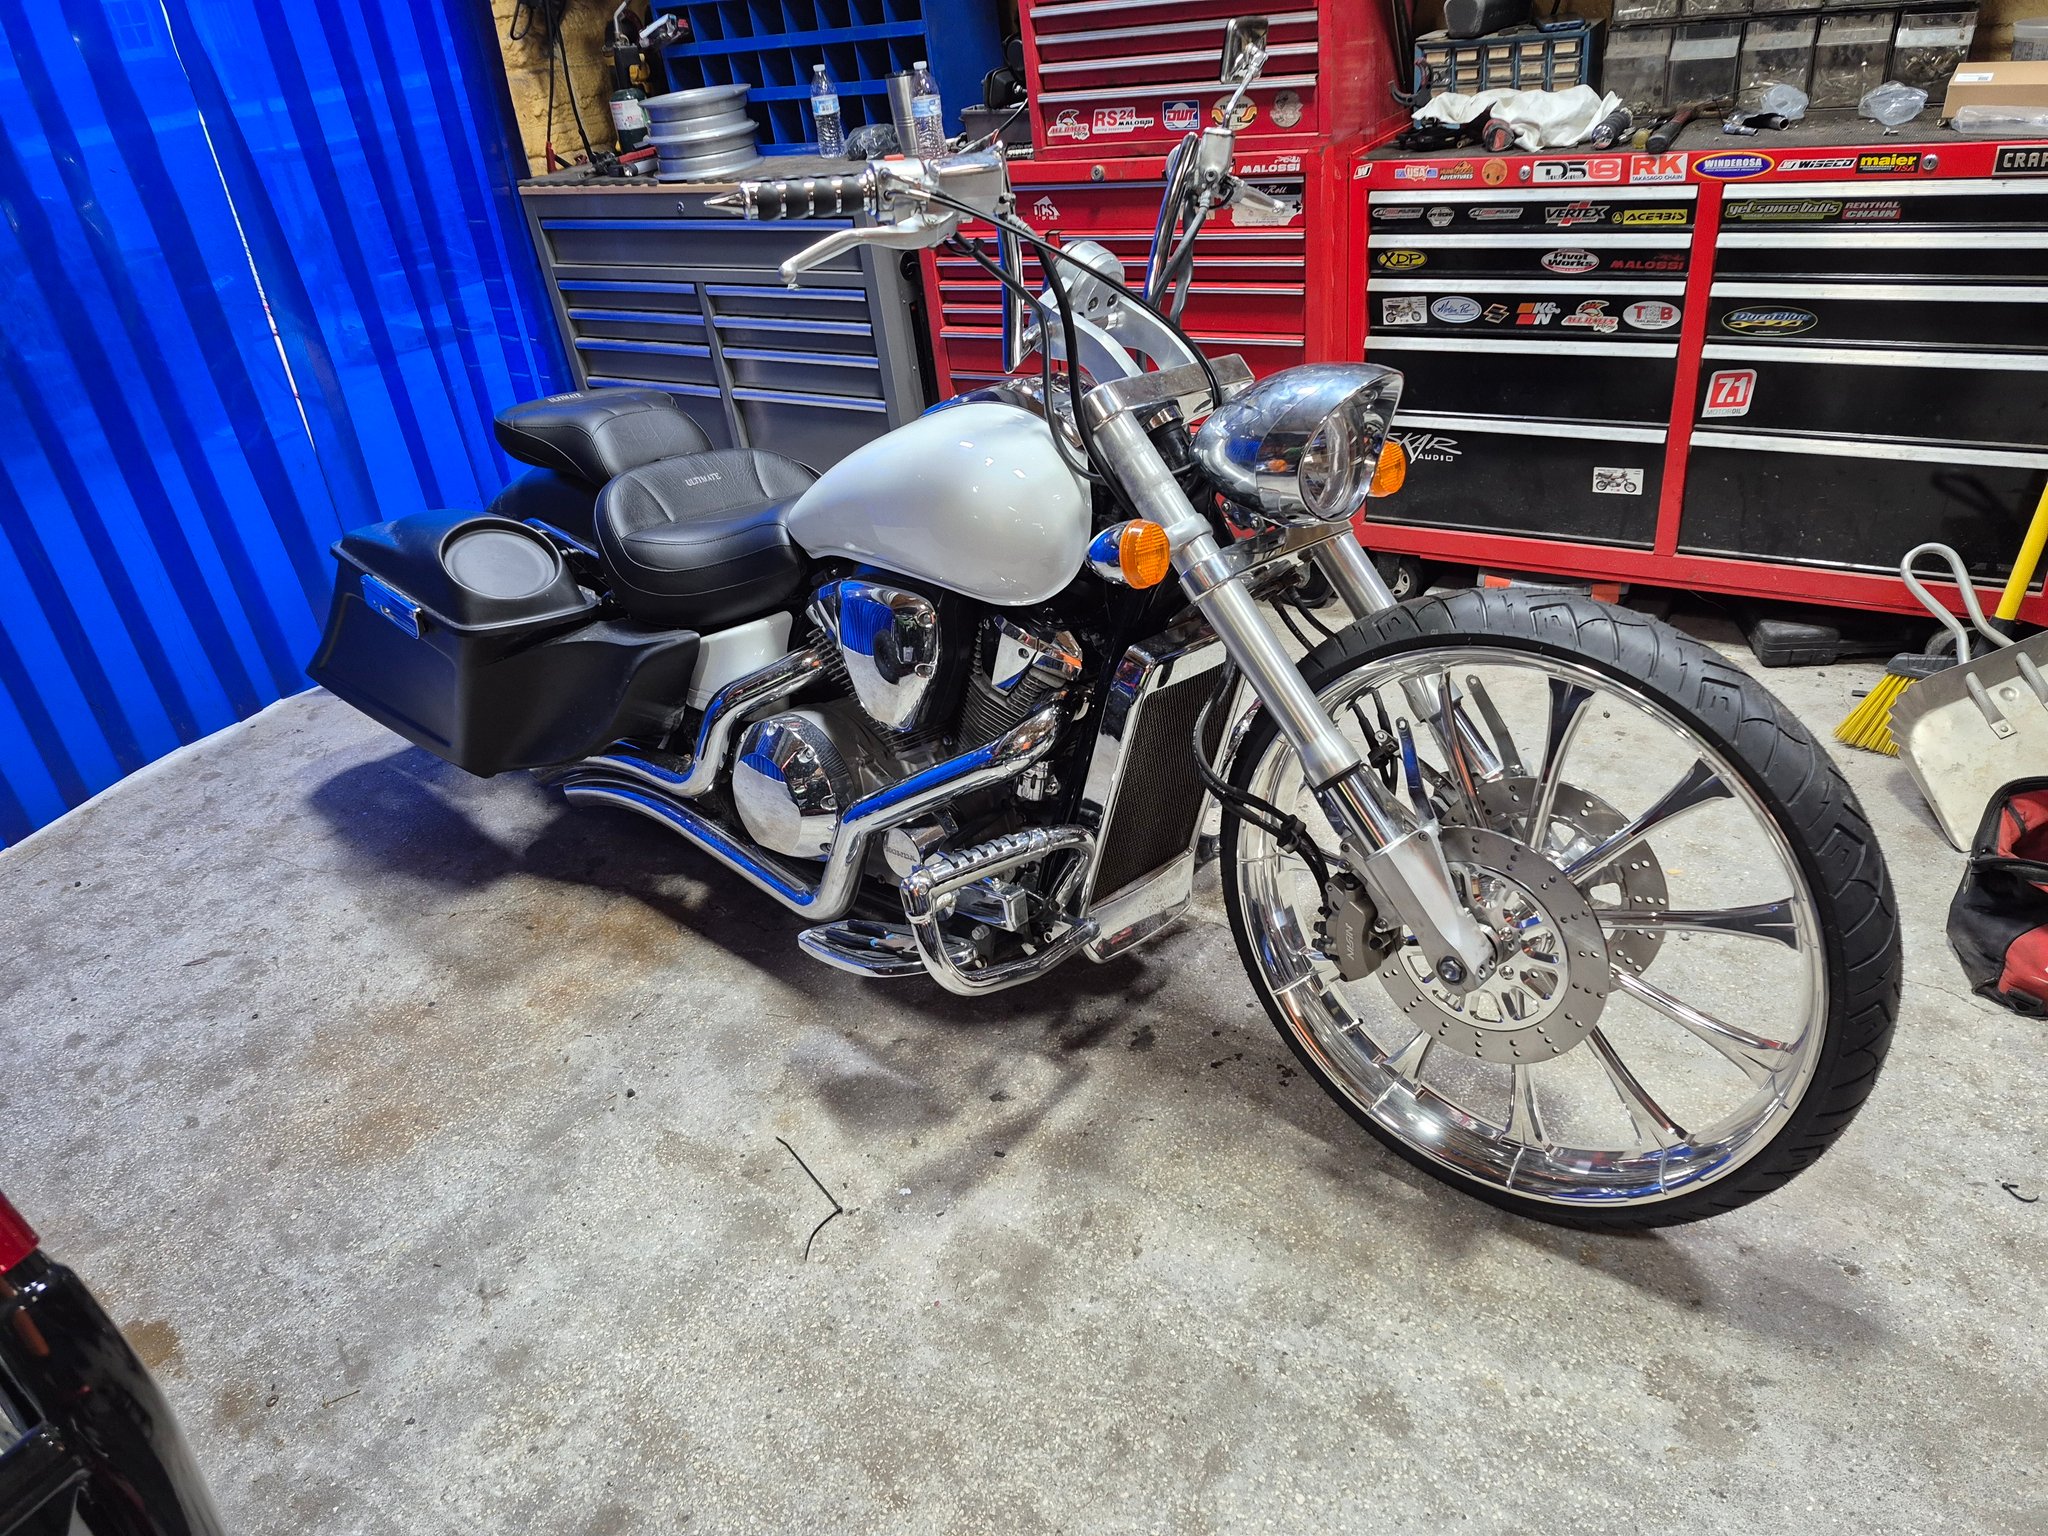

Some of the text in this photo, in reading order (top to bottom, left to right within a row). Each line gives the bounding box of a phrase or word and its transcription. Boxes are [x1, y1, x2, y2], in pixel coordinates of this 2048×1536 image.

[1632, 155, 1683, 175] RK
[1705, 158, 1762, 168] WINDEROSA
[1860, 154, 1917, 166] maier
[1240, 163, 1300, 173] MALOSSI
[1406, 166, 1426, 177] USA
[1535, 160, 1621, 180] DS18
[1844, 201, 1900, 209] RENTHAL
[1547, 207, 1607, 219] VERTEX
[1846, 209, 1898, 218] CHAIN
[1382, 251, 1421, 267] XDP
[1553, 252, 1589, 260] Pivot
[1548, 259, 1594, 267] Works
[1610, 260, 1684, 270] MALOSSI
[1716, 376, 1748, 404] 7.1
[548, 392, 584, 403] ULTIMATE
[1387, 432, 1463, 465] SKAR
[1418, 453, 1454, 462] AUDIO
[685, 472, 722, 487] ULTIMATE
[885, 846, 918, 863] HONDA
